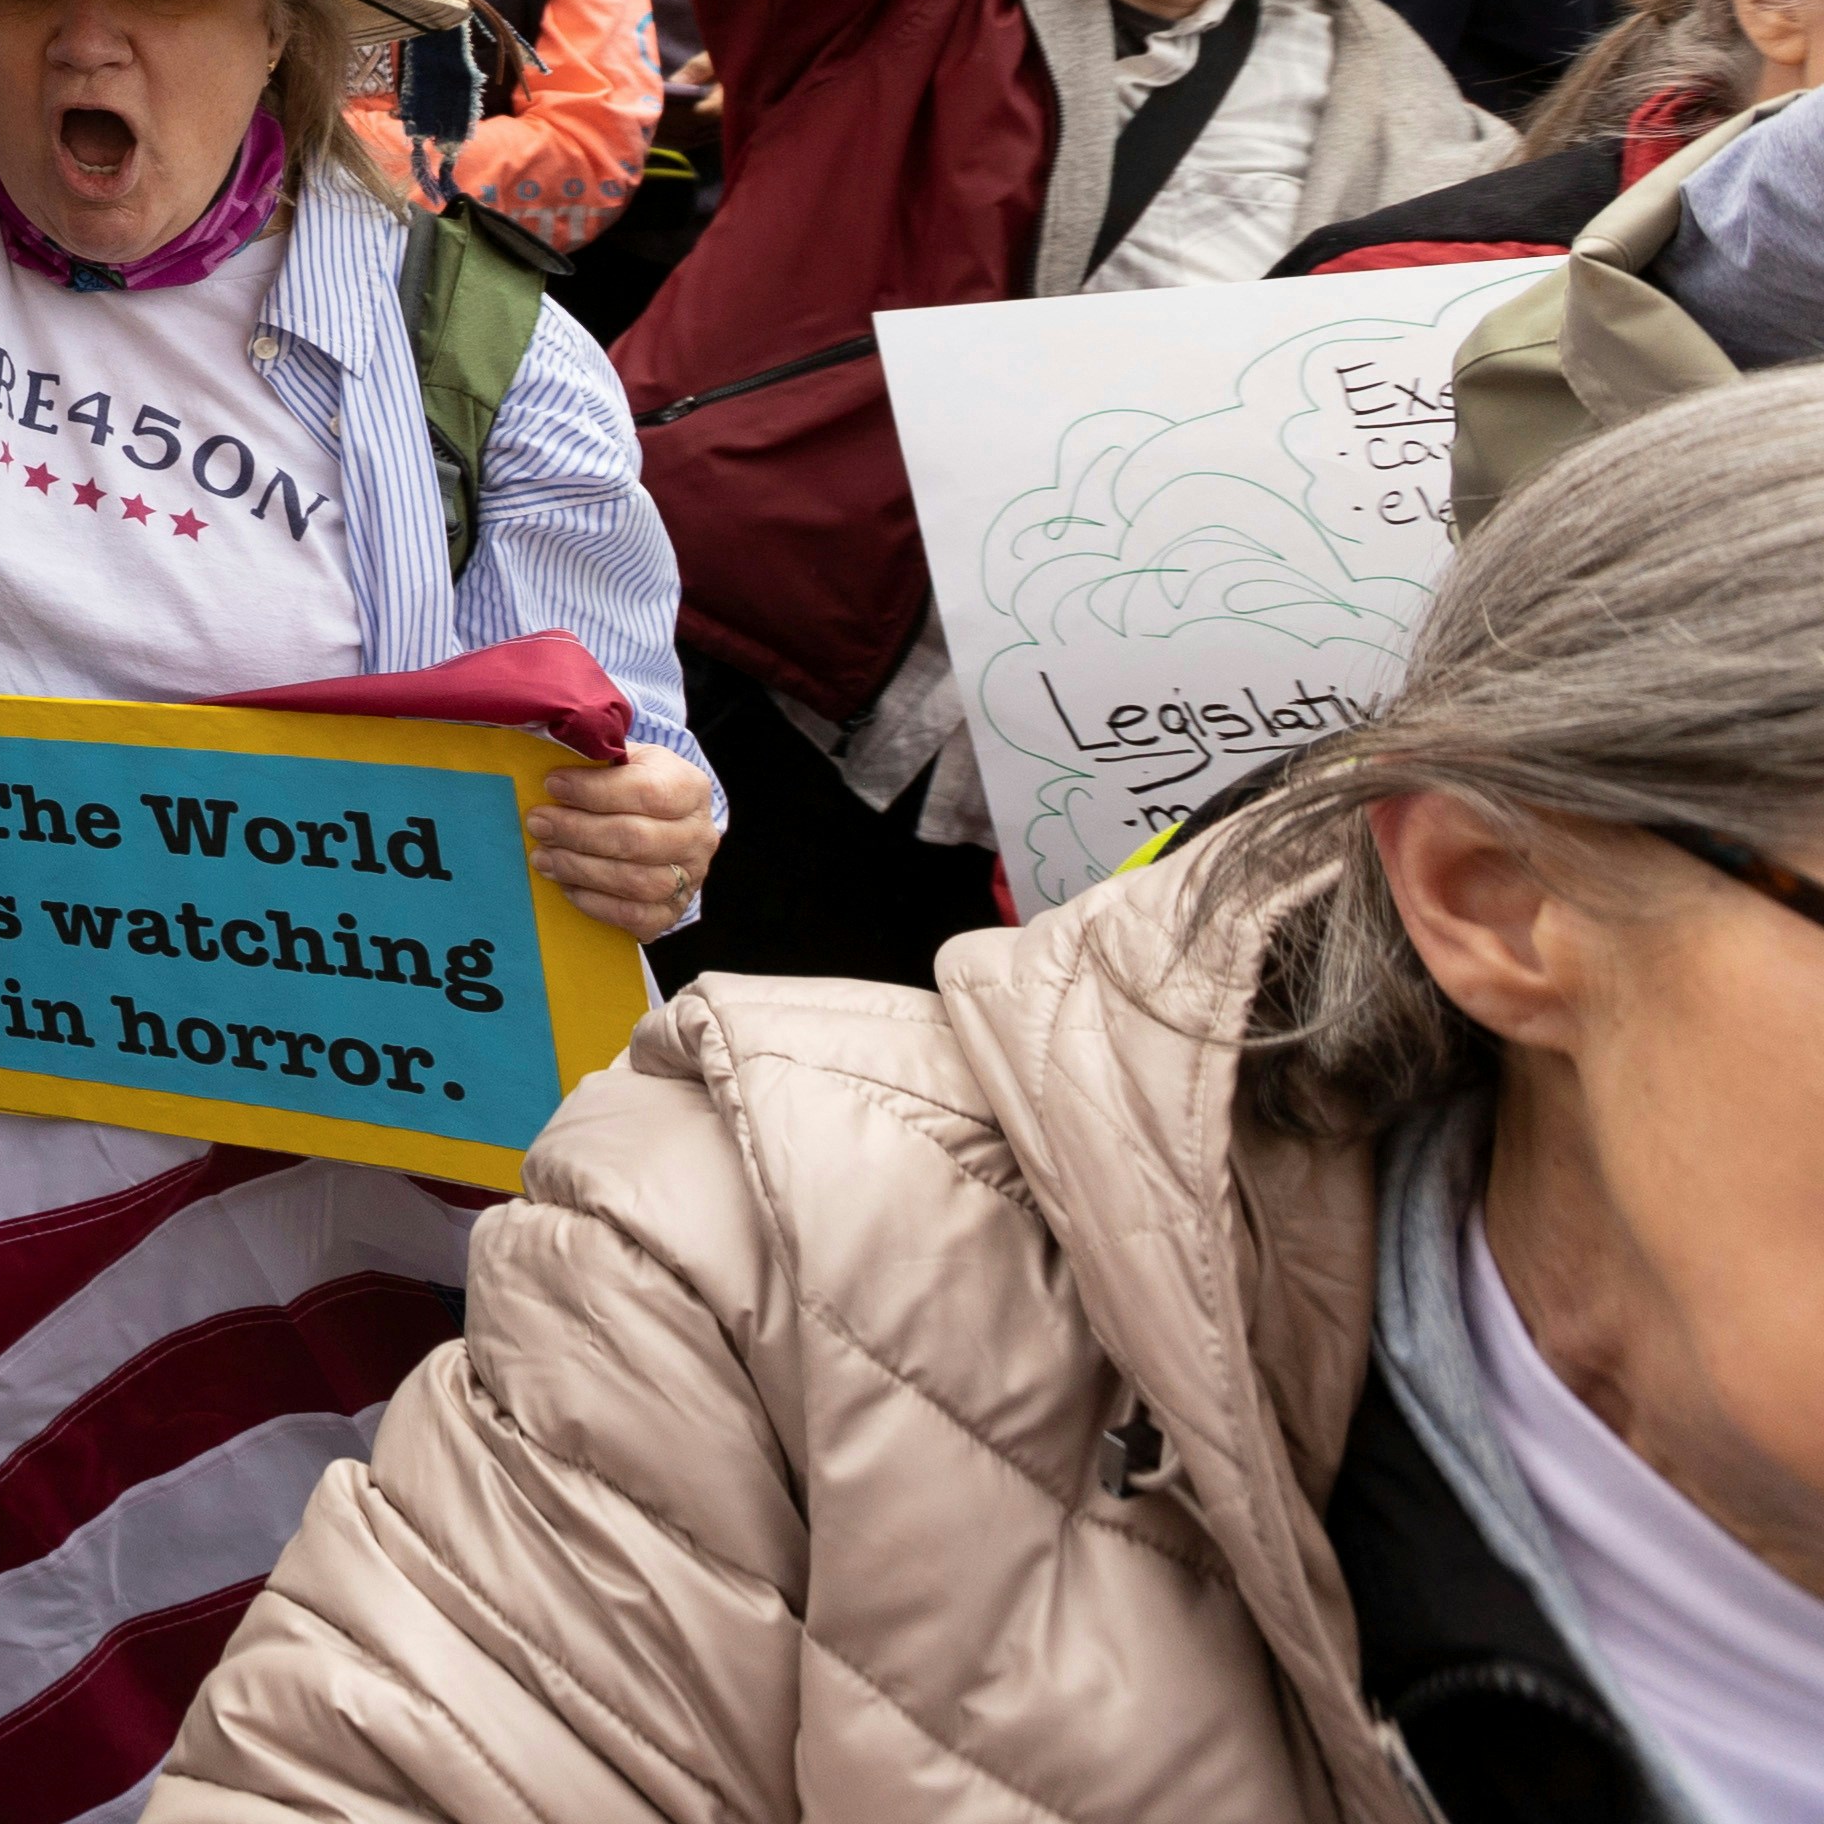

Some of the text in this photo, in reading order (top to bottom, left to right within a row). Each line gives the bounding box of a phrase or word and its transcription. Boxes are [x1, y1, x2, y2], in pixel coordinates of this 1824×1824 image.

[139, 793, 453, 883] World
[40, 902, 506, 1014] watching
[0, 977, 468, 1104] in horror.
